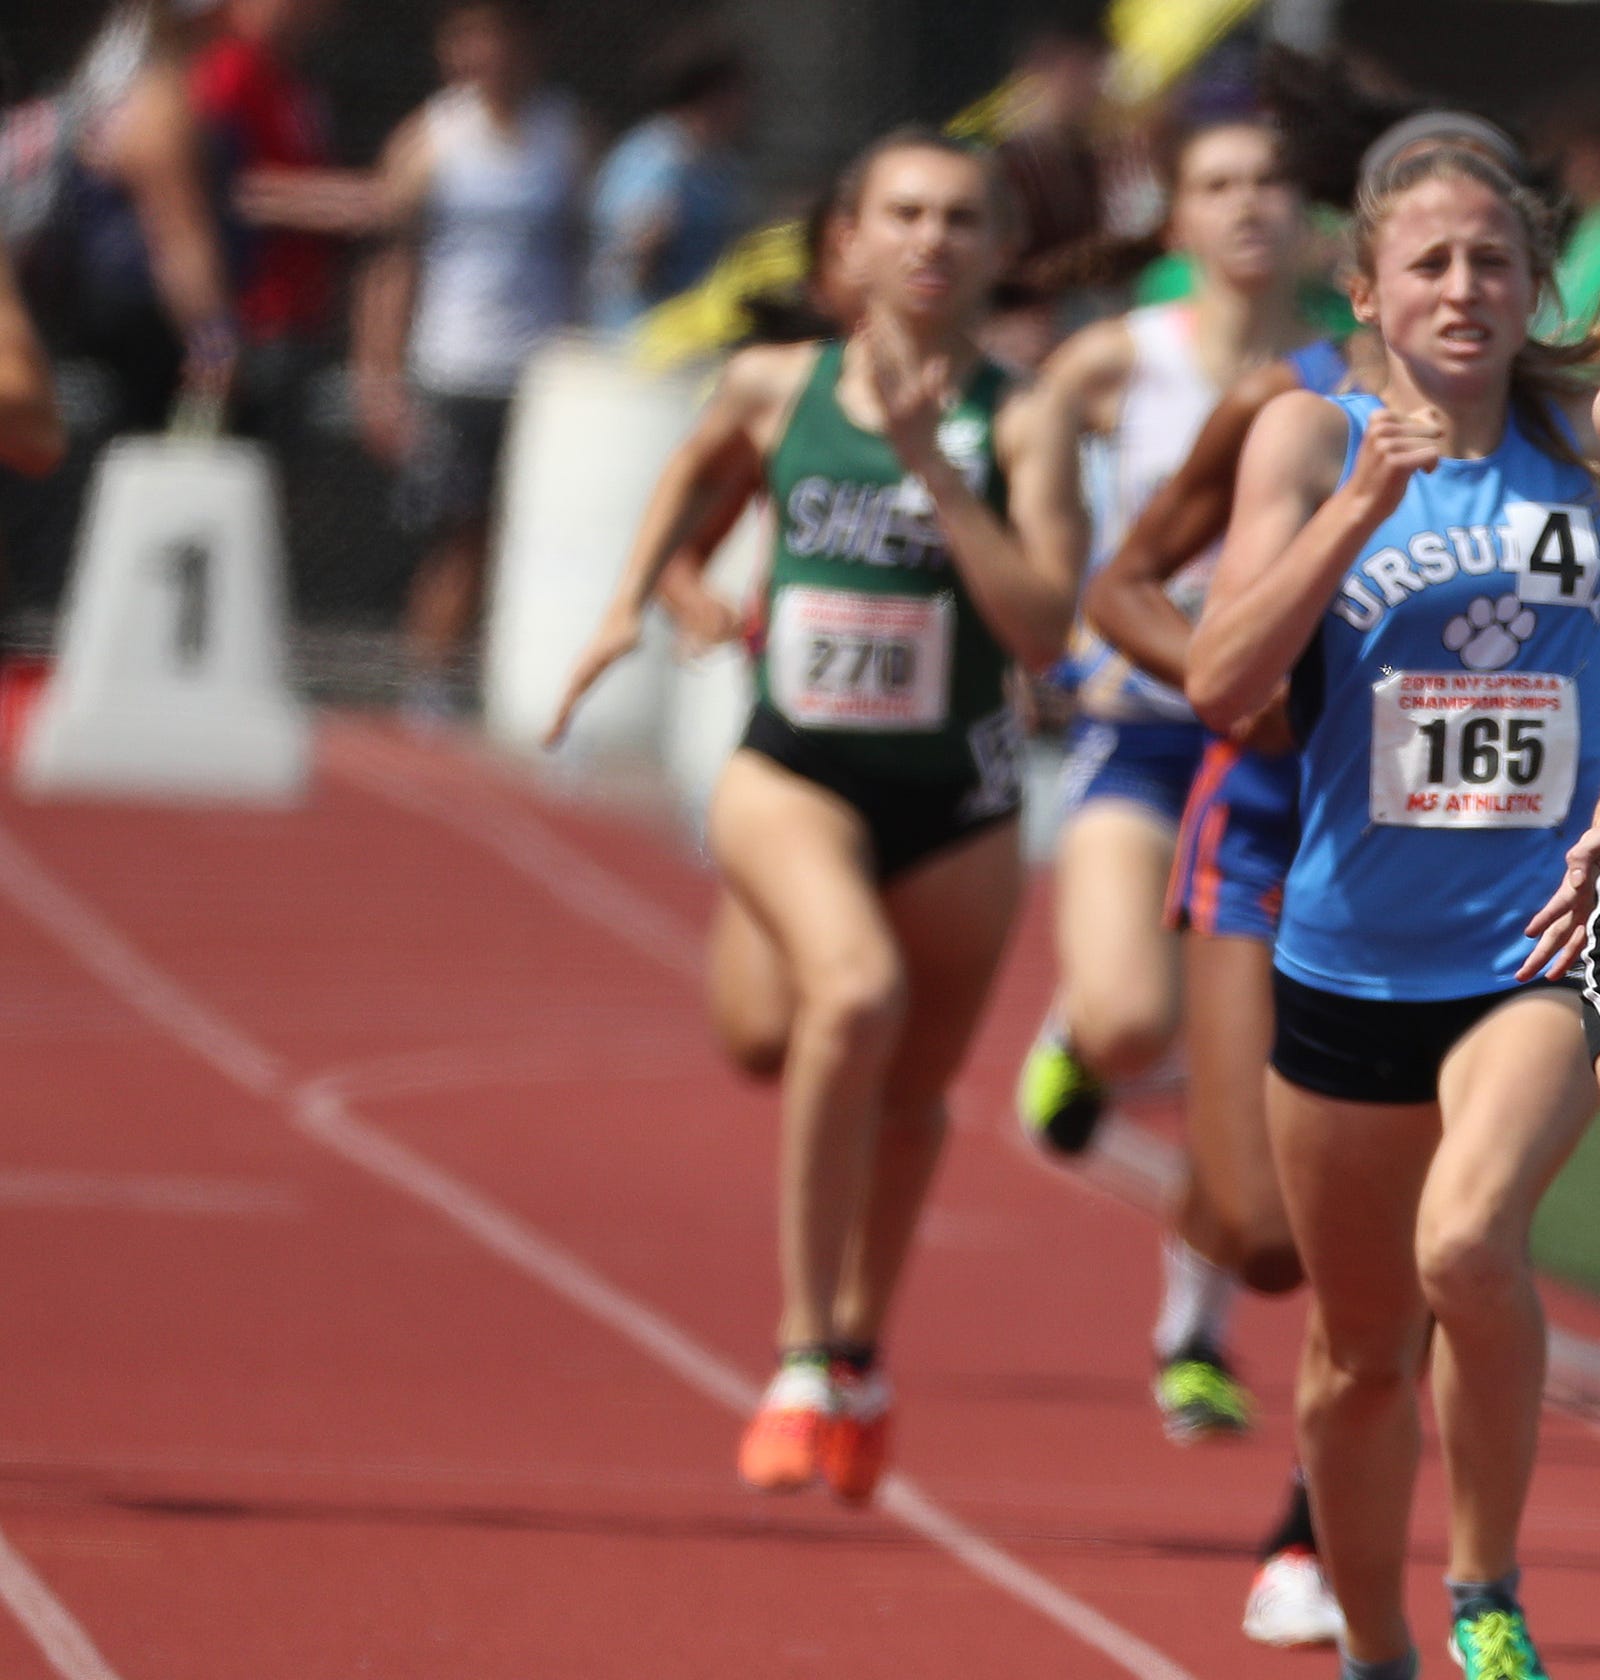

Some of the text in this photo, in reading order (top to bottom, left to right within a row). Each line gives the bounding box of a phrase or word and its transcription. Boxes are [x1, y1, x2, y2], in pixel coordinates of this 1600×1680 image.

[1530, 512, 1585, 597] 4
[150, 540, 210, 668] 1
[1399, 695, 1561, 711] CHAMPIONSHIPS
[1401, 674, 1446, 691] 2018
[1419, 718, 1544, 785] 165
[1445, 793, 1543, 813] ATHLETIC
